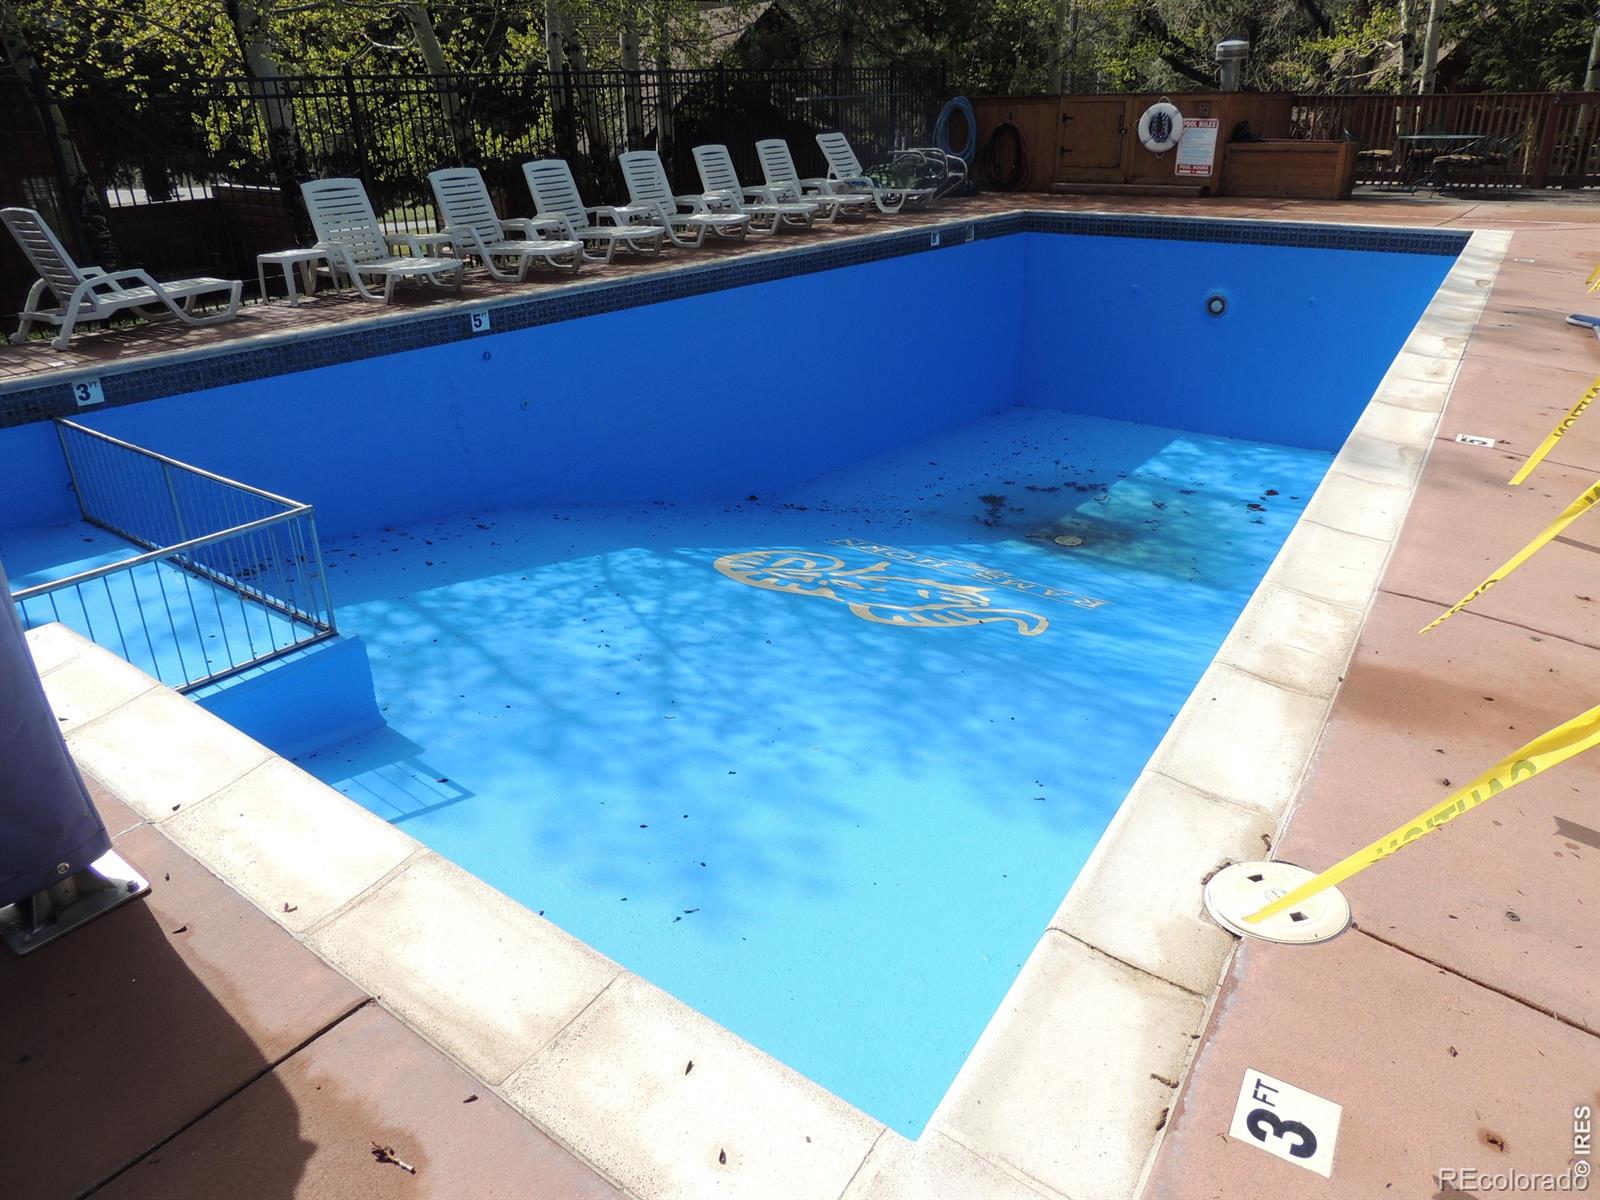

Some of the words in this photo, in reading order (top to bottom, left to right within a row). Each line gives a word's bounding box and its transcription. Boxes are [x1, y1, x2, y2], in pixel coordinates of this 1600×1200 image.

[1183, 121, 1197, 129] POOL
[1199, 121, 1217, 129] RULES
[473, 313, 483, 328] 5
[76, 383, 91, 401] 3
[1252, 1078, 1280, 1107] FT
[1246, 1108, 1318, 1159] 3
